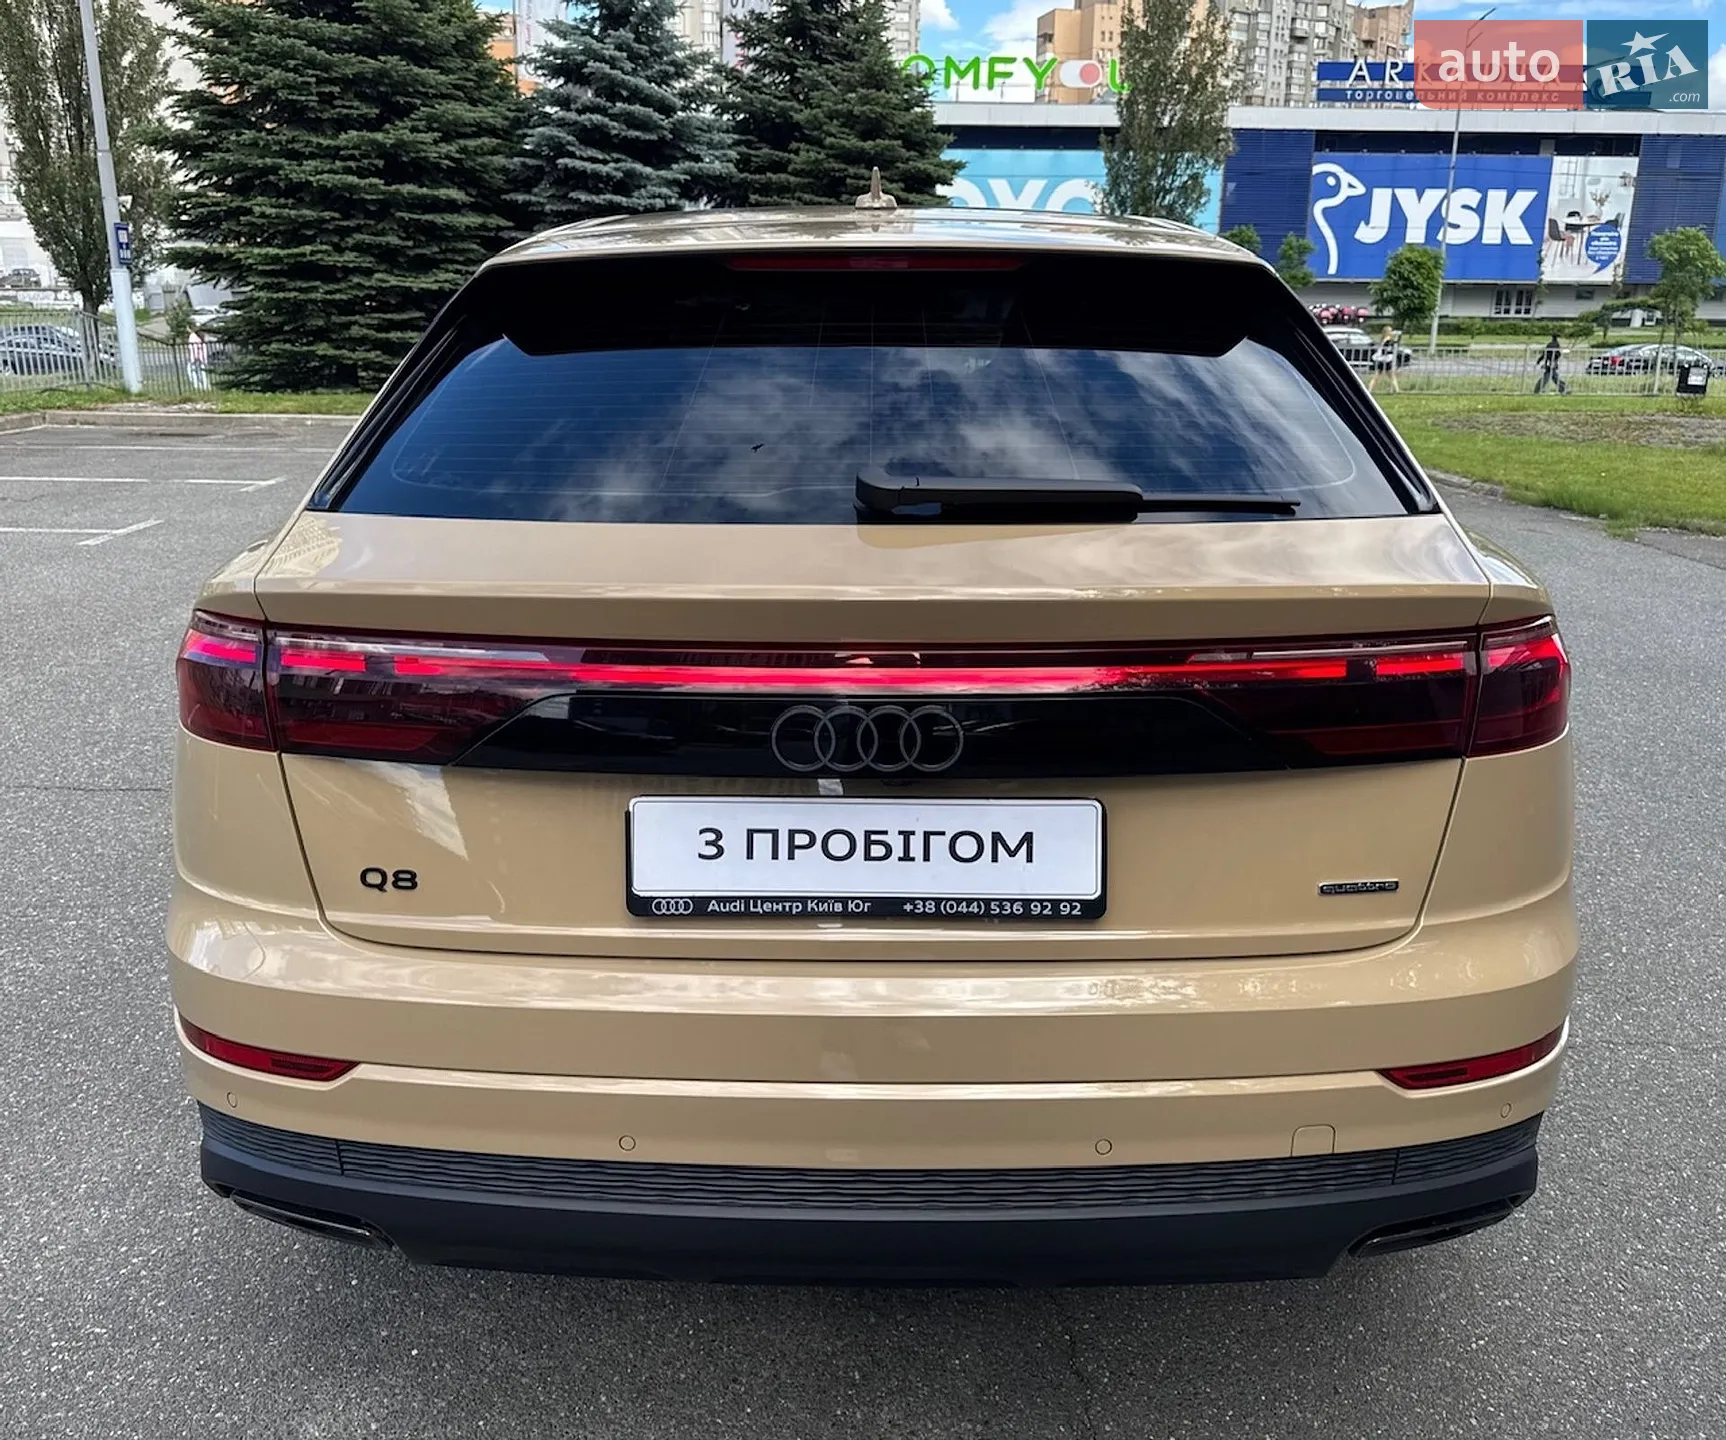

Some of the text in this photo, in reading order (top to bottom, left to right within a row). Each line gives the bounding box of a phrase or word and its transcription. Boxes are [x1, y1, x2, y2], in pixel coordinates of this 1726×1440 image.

[1354, 187, 1538, 245] JYSK
[746, 828, 1034, 864] ПРОБІГОМ
[360, 867, 418, 892] Q8
[1323, 882, 1396, 893] quattro
[707, 899, 872, 915] Audi Центр Київ Юг
[903, 900, 1082, 915] +38 (044) 536 92 92
